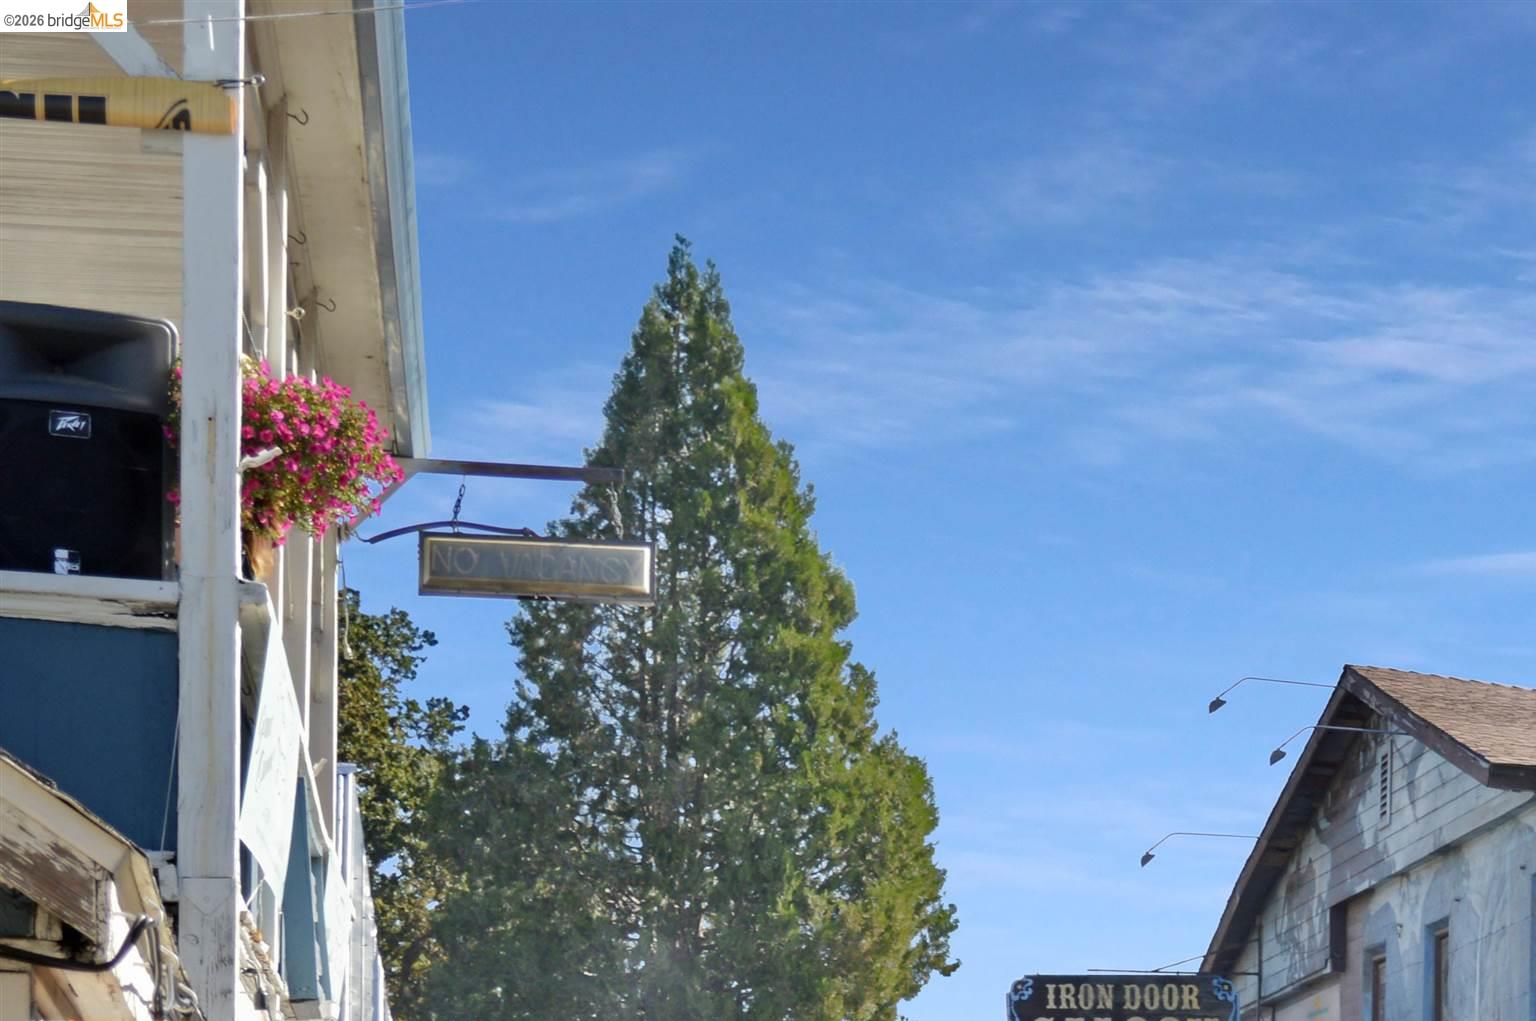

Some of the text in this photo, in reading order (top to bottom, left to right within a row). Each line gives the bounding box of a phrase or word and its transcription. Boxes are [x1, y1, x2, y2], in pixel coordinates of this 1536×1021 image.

[431, 543, 478, 575] NO
[1046, 983, 1201, 1010] IRON DOOR
